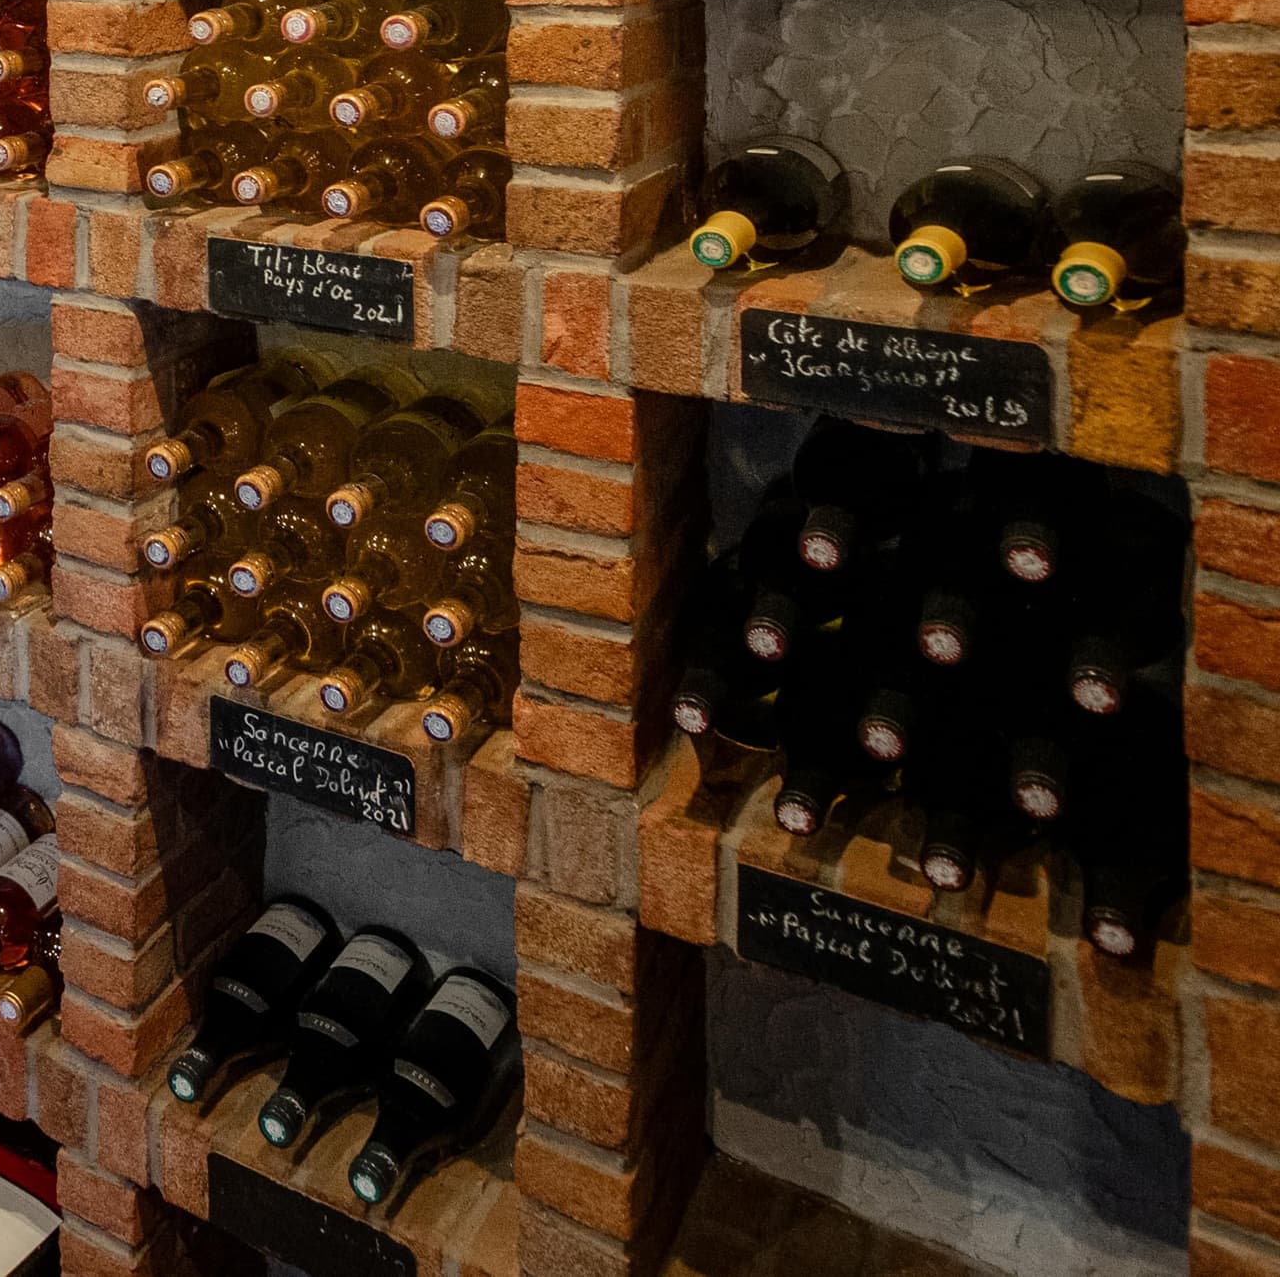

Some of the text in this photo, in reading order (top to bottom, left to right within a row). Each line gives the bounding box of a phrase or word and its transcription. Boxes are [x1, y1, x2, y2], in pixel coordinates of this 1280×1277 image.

[247, 244, 297, 273] Titi
[263, 269, 304, 297] Pays
[351, 302, 403, 323] 2021
[836, 327, 869, 353] de
[243, 712, 360, 769] Sancerre
